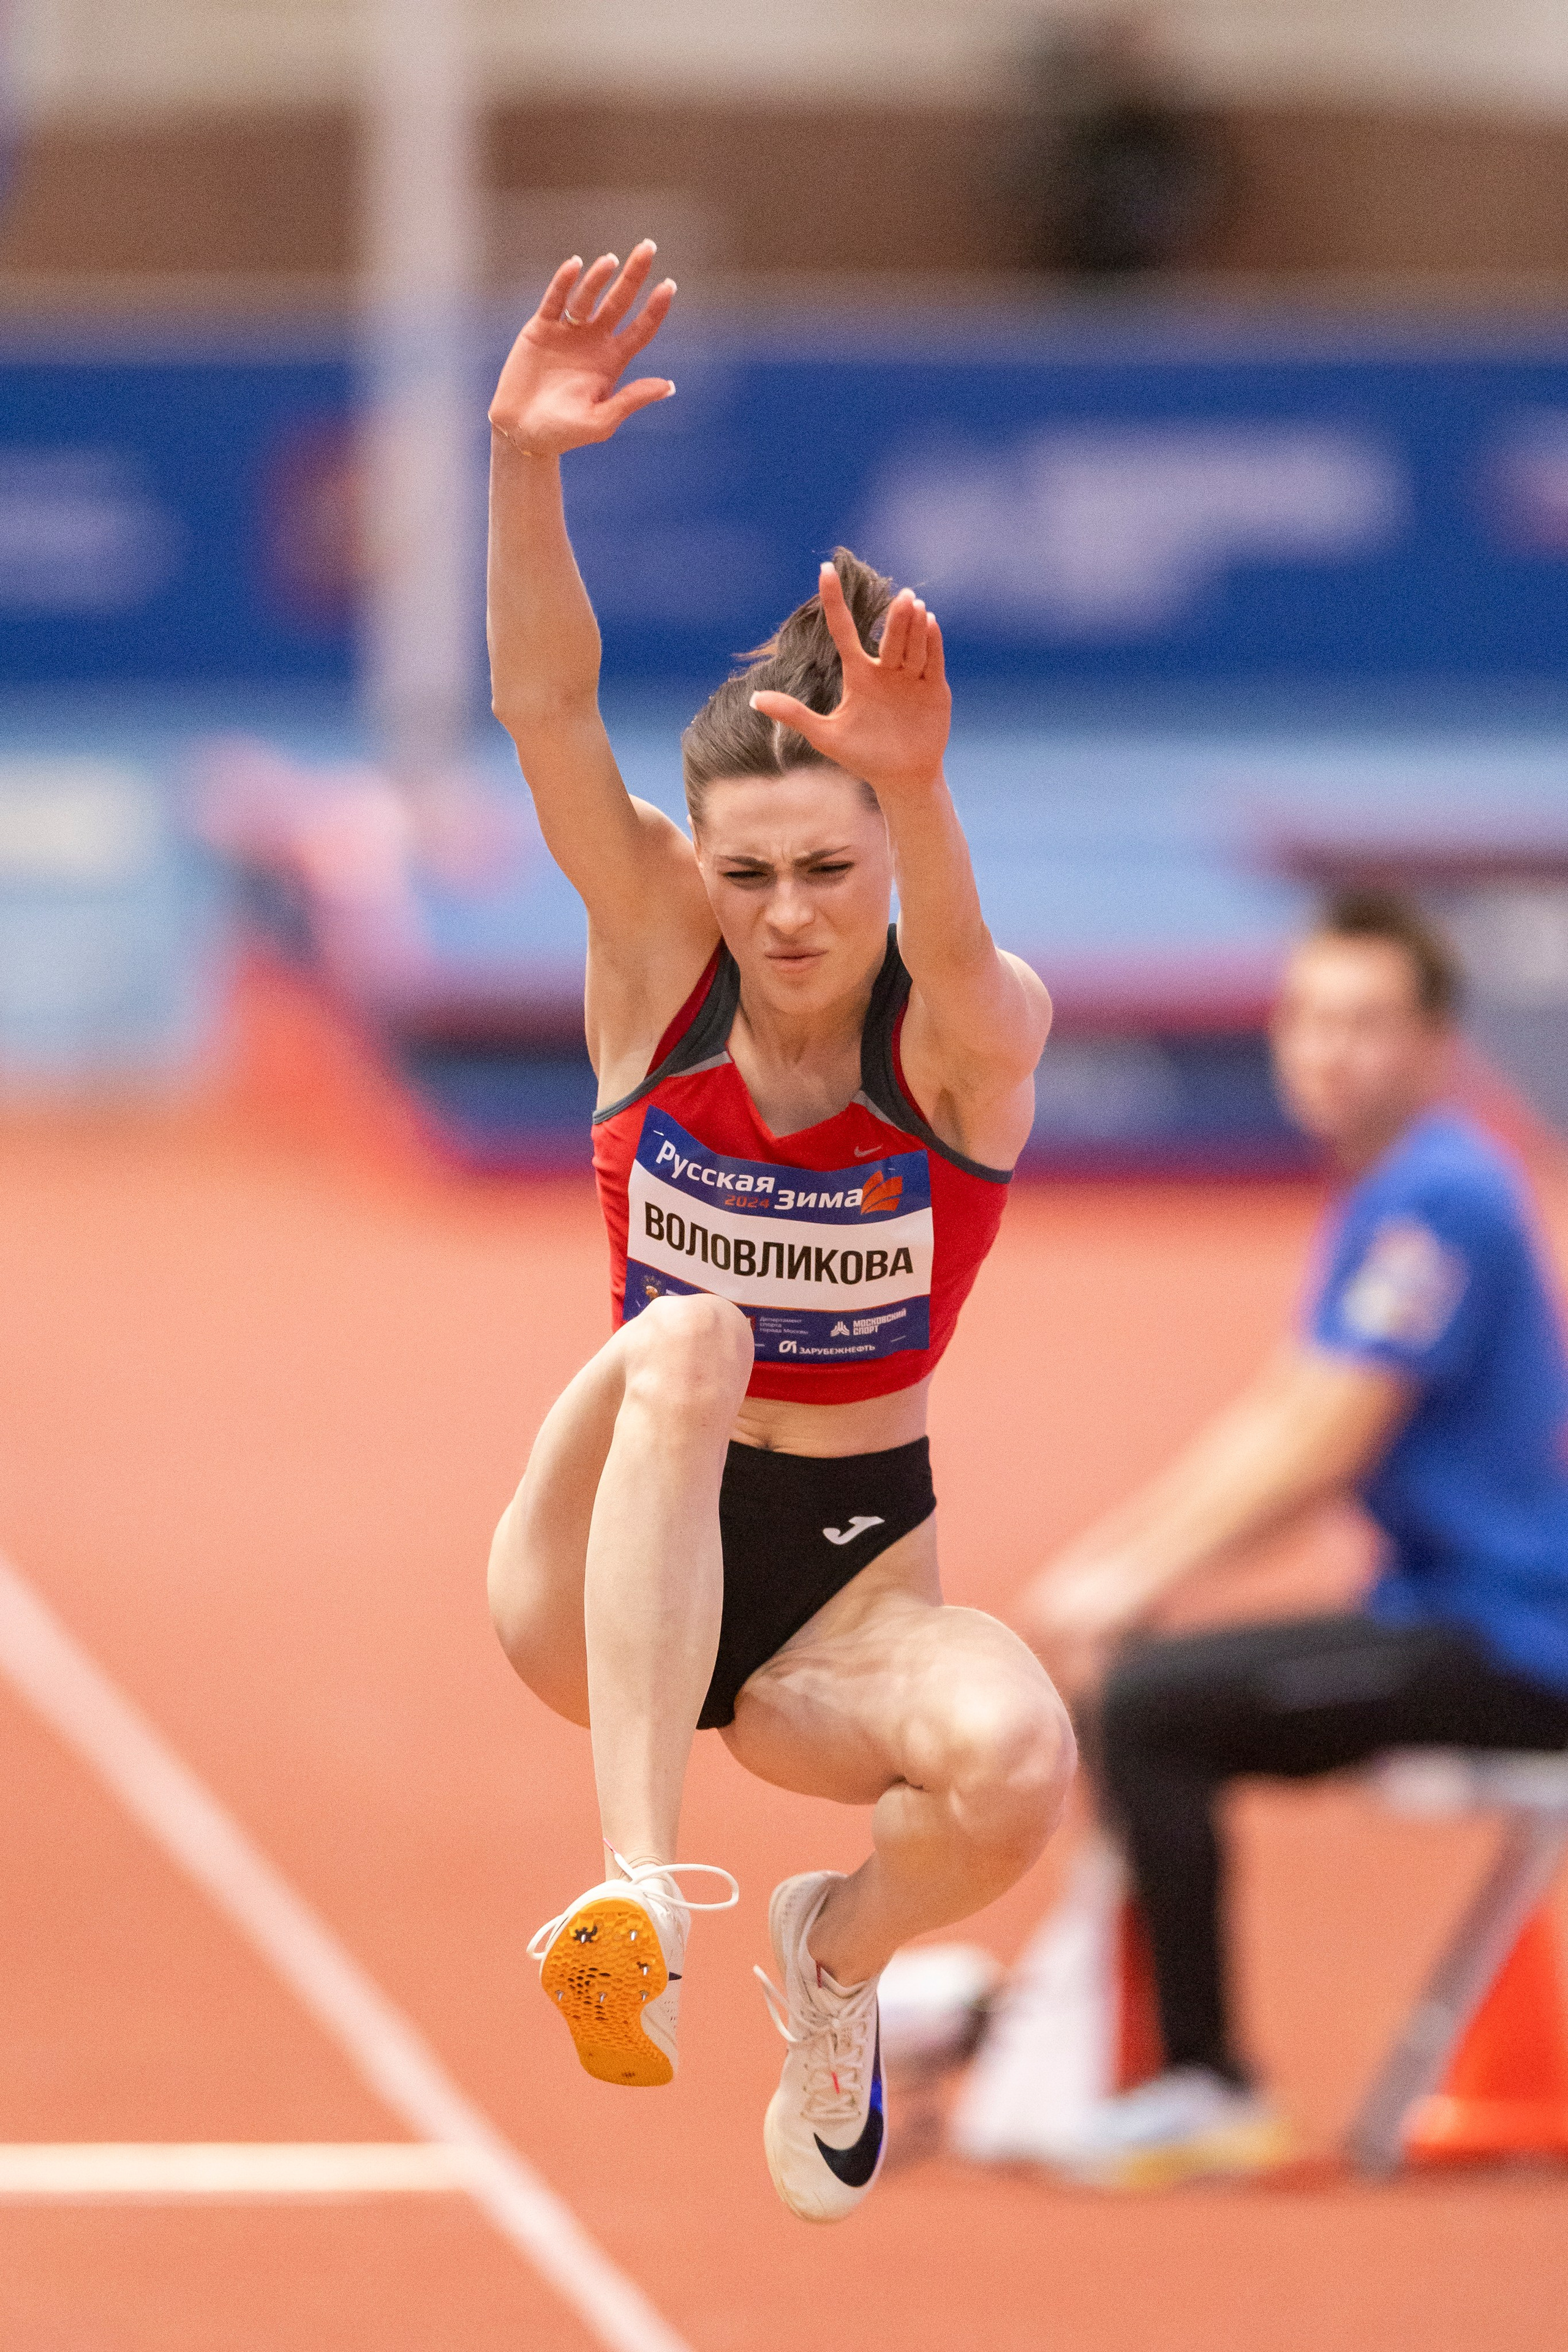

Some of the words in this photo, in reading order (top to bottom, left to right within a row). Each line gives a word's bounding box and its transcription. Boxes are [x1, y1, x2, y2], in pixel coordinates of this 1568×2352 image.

[655, 1140, 775, 1193] Русская
[725, 1194, 770, 1208] 2024
[645, 1202, 914, 1285] ВОЛОВЛИКОВА
[853, 1308, 907, 1327] МОСКОВСКИЙ
[853, 1325, 879, 1336] СПОРТ
[799, 1344, 876, 1355] ЗАРУБЕЖНЕФТЬ
